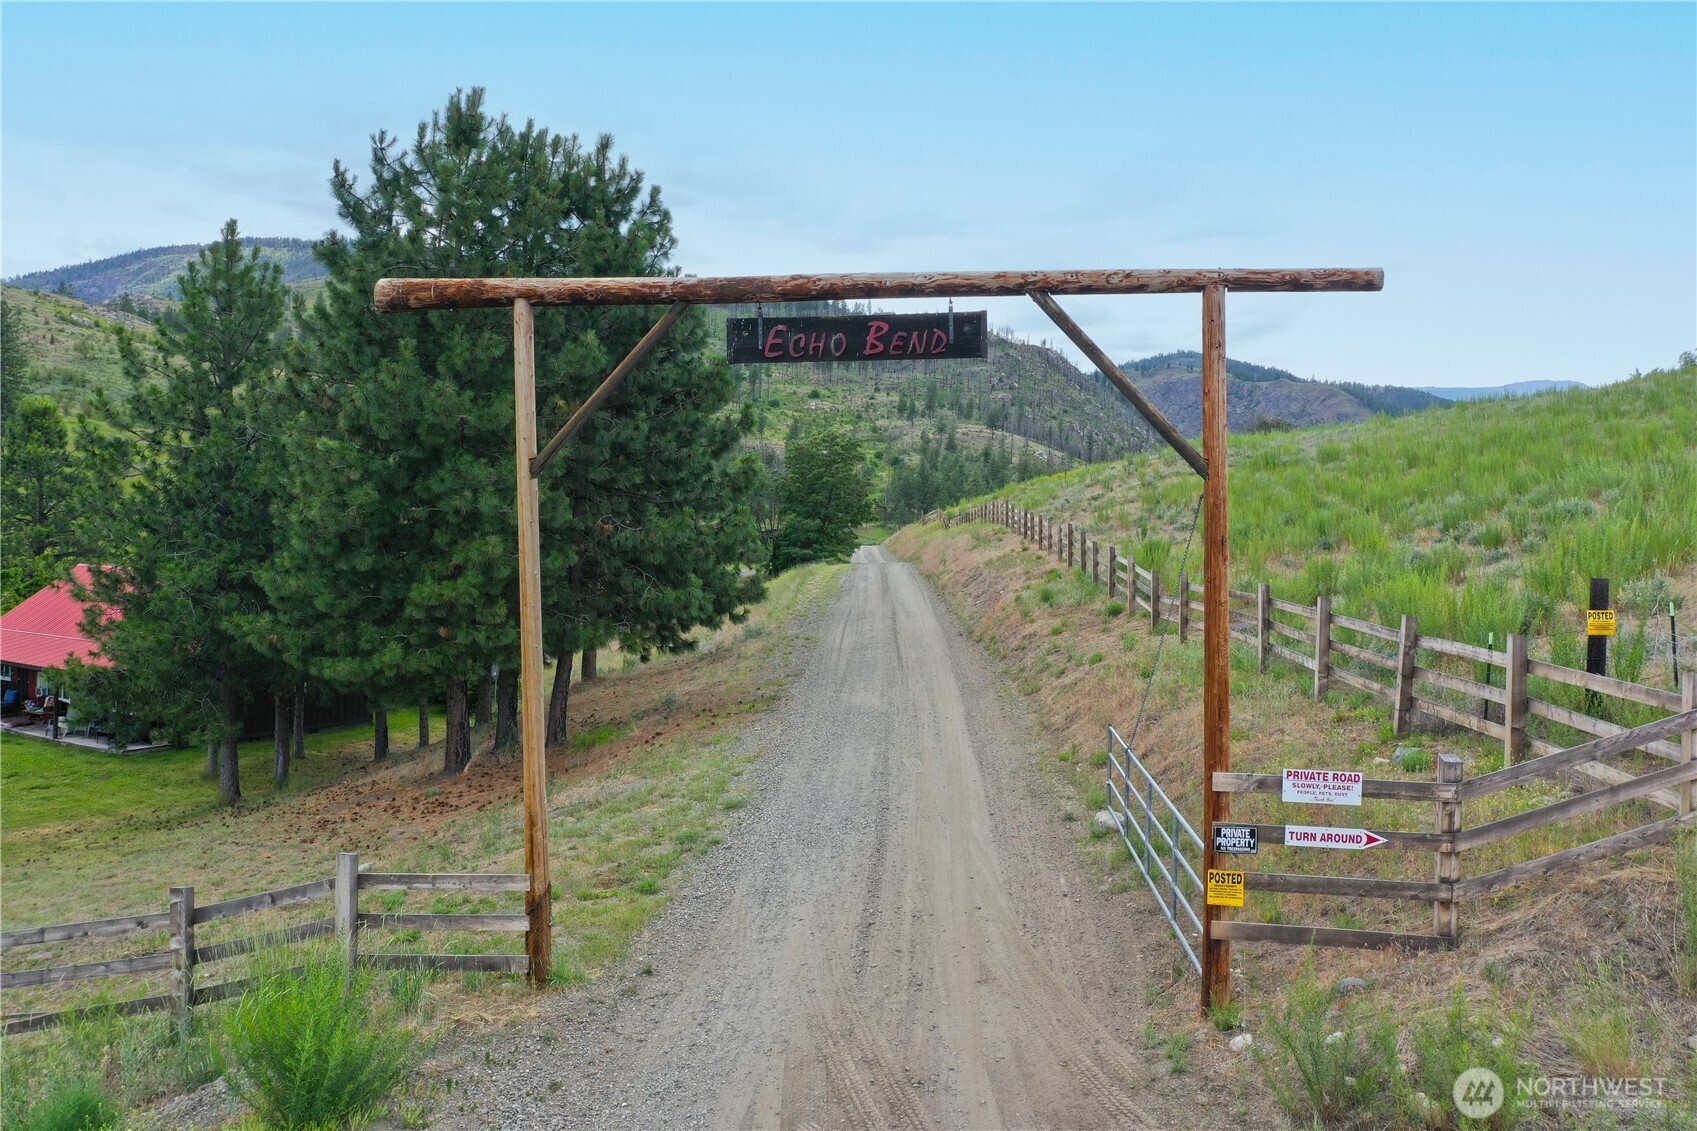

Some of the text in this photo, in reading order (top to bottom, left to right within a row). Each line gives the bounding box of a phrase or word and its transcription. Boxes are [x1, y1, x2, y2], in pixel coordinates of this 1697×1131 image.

[764, 321, 947, 358] ECHO BEND
[1588, 612, 1613, 620] POSTED
[1287, 770, 1360, 783] PRIVATE ROAD
[1222, 828, 1250, 838] PRIVATE
[1289, 832, 1362, 844] TURN AROUND
[1216, 837, 1254, 848] PROPERTY
[1209, 872, 1242, 884] POSTED
